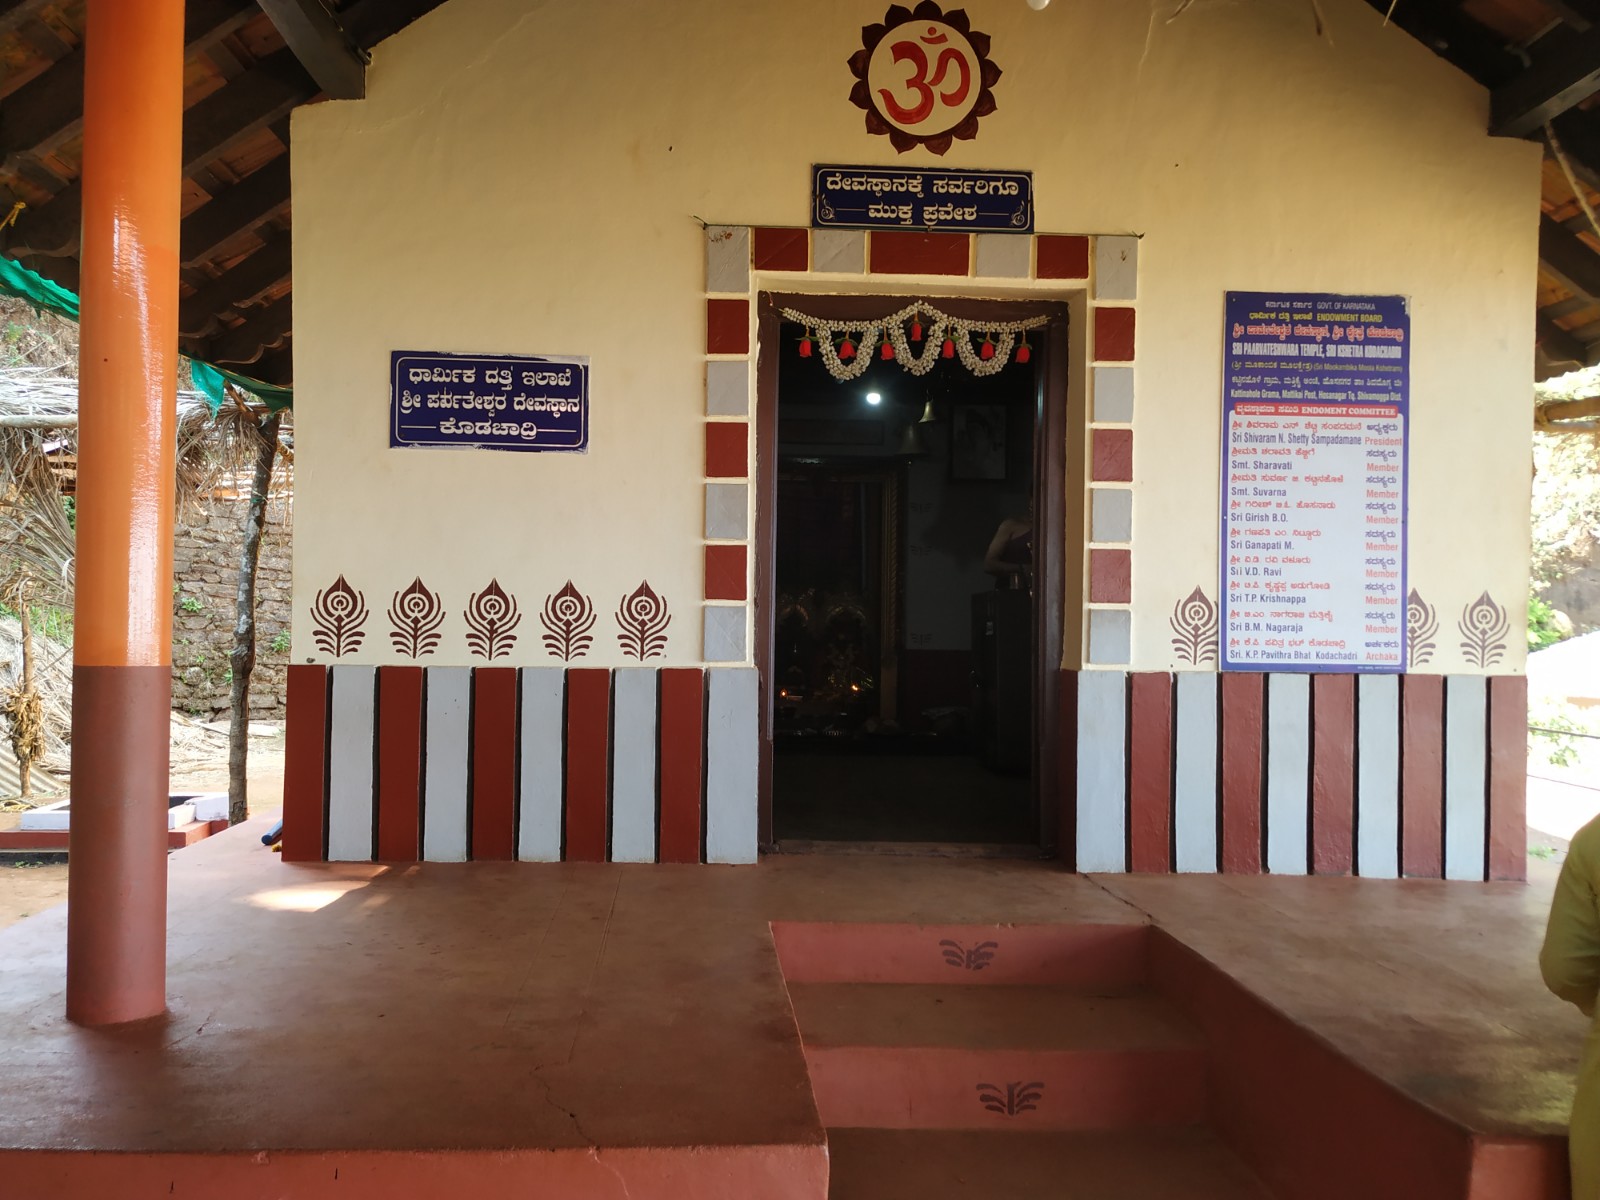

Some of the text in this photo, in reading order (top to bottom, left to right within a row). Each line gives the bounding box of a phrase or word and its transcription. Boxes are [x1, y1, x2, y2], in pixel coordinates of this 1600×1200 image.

[826, 173, 1019, 197] ದೇವಸ್ಥಾನಕ್ಕೆ ಸರ್ವರಿಗೂ
[868, 202, 977, 225] ಮುಕ್ತ ಪ್ರವೇಶ
[1232, 342, 1242, 355] SRI
[1301, 344, 1324, 358] TEMPLE,
[1326, 344, 1336, 357] SRI
[409, 366, 571, 390] ಧಾರ್ಮಿಕ ದತ್ತಿ ಇಲಾಖೆ
[400, 390, 421, 413] ಶ್ರೀ
[514, 393, 580, 418] ದೇವಸ್ಥಾನ
[440, 418, 537, 440] ಕೊಡಚಾದ್ರಿ
[1232, 421, 1242, 430] ಶ್ರೀ
[1232, 432, 1362, 446] Sri Shivaram N. Shetty Sampadamane
[1365, 437, 1402, 445] President
[1232, 448, 1257, 456] ಶ್ರೀಮತಿ
[1366, 450, 1397, 461] ಸದಸ್ಯರು
[1232, 461, 1292, 470] Smt. Sharavati
[1367, 463, 1399, 471] Member
[1231, 474, 1257, 482] ಶ್ರೀಮತಿ
[1366, 476, 1397, 488] ಸದಸ್ಯರು
[1232, 487, 1287, 496] Smt. Suvarna
[1366, 490, 1398, 498] Member
[1231, 501, 1241, 510] ಶ್ರೀ
[1365, 502, 1396, 514] ಸದಸ್ಯರು
[1231, 513, 1288, 522] Sri Girish B.O.
[1366, 516, 1398, 524] Member
[1230, 528, 1240, 537] ಶ್ರೀ
[1365, 530, 1396, 542] ಸದಸ್ಯರು
[1231, 540, 1294, 551] Sri Ganapati M.
[1366, 542, 1398, 551] Member
[1230, 556, 1240, 564] ಶ್ರೀ
[1365, 558, 1396, 569] ಸದಸ್ಯರು
[1245, 567, 1260, 576] V.D.
[1263, 568, 1281, 576] Ravi
[1366, 569, 1398, 578] Member
[1230, 581, 1240, 590] ಶ್ರೀ
[1365, 583, 1395, 595] ಸದಸ್ಯರು
[1230, 594, 1306, 604] Sri T.P. Krishnappa
[1230, 610, 1240, 619] ಶ್ರೀ
[1365, 612, 1395, 623] ಸದಸ್ಯರು
[1230, 623, 1303, 634] Sri B.M. Nagaraja
[1366, 625, 1398, 633] Member
[1230, 638, 1240, 647] ಶ್ರೀ
[1230, 650, 1358, 660] Sri. K.P. Pavithra Bhat Kodachadri
[1366, 652, 1398, 660] Archaka
